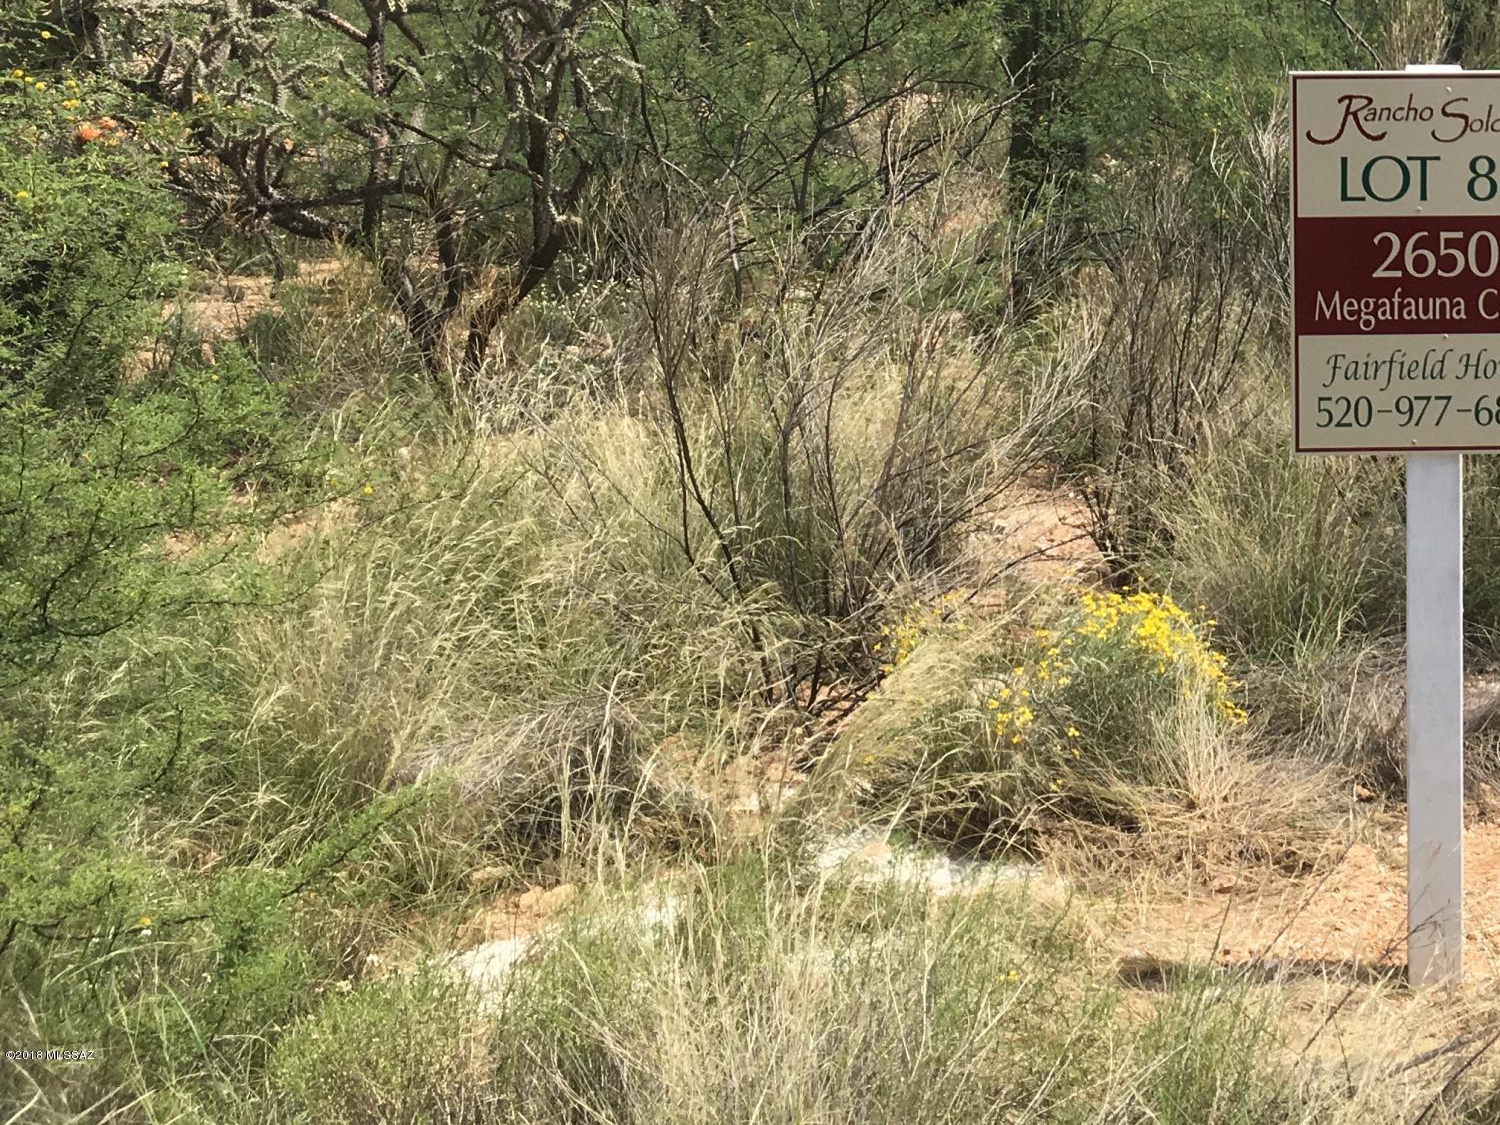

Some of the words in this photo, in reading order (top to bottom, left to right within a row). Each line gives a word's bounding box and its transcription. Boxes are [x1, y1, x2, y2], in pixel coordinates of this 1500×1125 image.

[1305, 93, 1434, 145] Rancho
[1340, 155, 1441, 203] LOT
[1372, 230, 1500, 278] 2650
[1314, 287, 1467, 331] Megafauna
[1322, 348, 1454, 391] Fairfield
